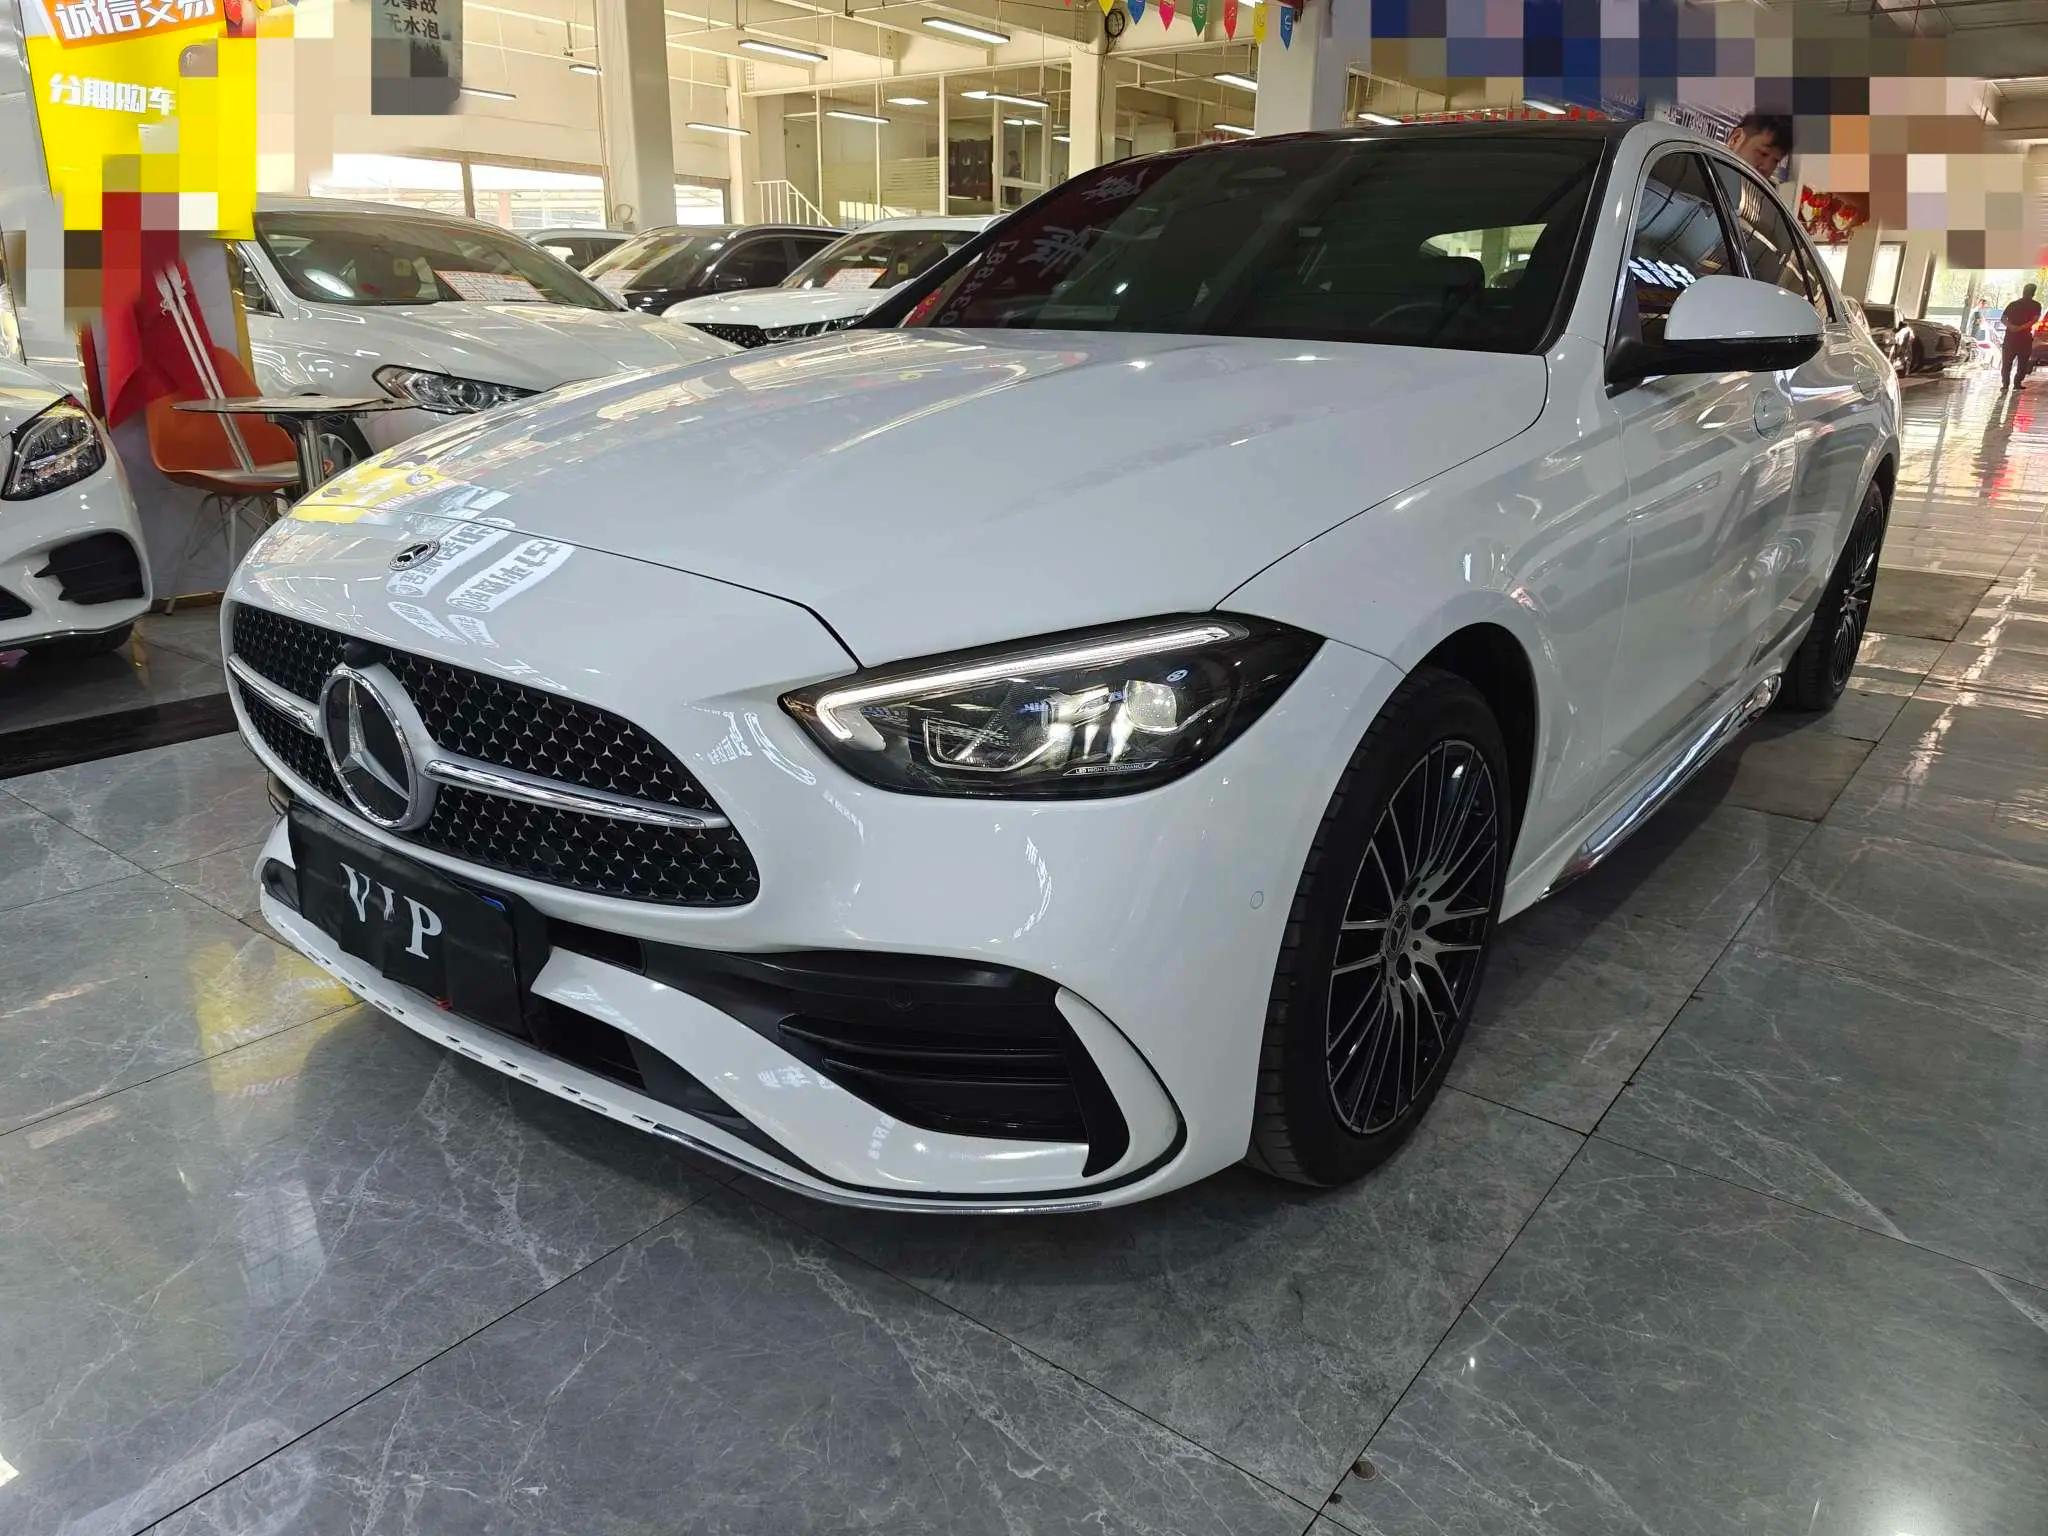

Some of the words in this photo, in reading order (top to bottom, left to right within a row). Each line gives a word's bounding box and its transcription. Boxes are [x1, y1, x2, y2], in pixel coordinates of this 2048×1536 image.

[385, 12, 441, 40] 无水泡
[48, 72, 177, 116] 分期购车
[339, 862, 443, 960] VIP
